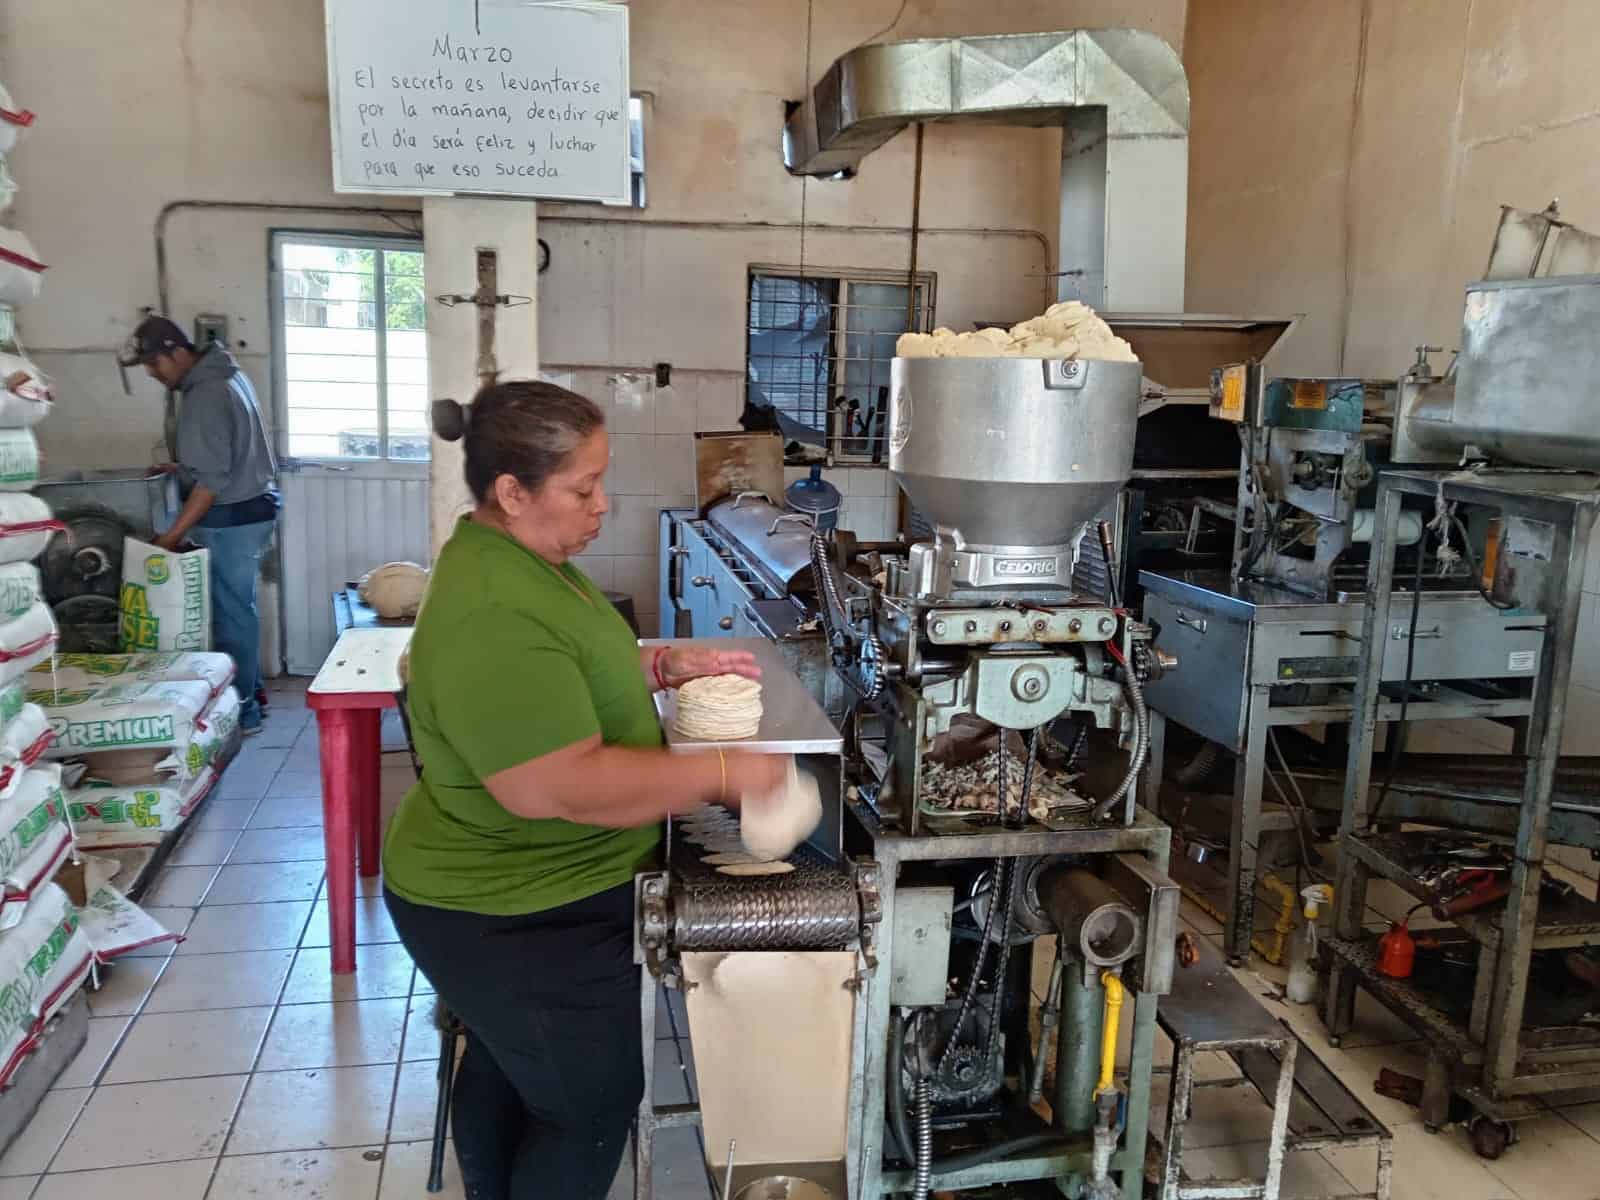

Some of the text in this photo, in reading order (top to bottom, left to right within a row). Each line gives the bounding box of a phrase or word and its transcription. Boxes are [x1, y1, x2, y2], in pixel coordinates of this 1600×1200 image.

[432, 33, 512, 63] Marzo
[356, 66, 600, 93] El secreto es levantarse
[359, 96, 619, 128] por la mañana, decidir que
[361, 128, 378, 148] el
[433, 128, 464, 149] será
[528, 139, 536, 156] y
[550, 132, 597, 152] luchar
[364, 160, 398, 181] para
[415, 162, 435, 182] que
[453, 164, 480, 177] eso
[996, 560, 1054, 574] CELORIO
[175, 555, 202, 650] PREMIUM
[48, 715, 173, 747] PREMIUM
